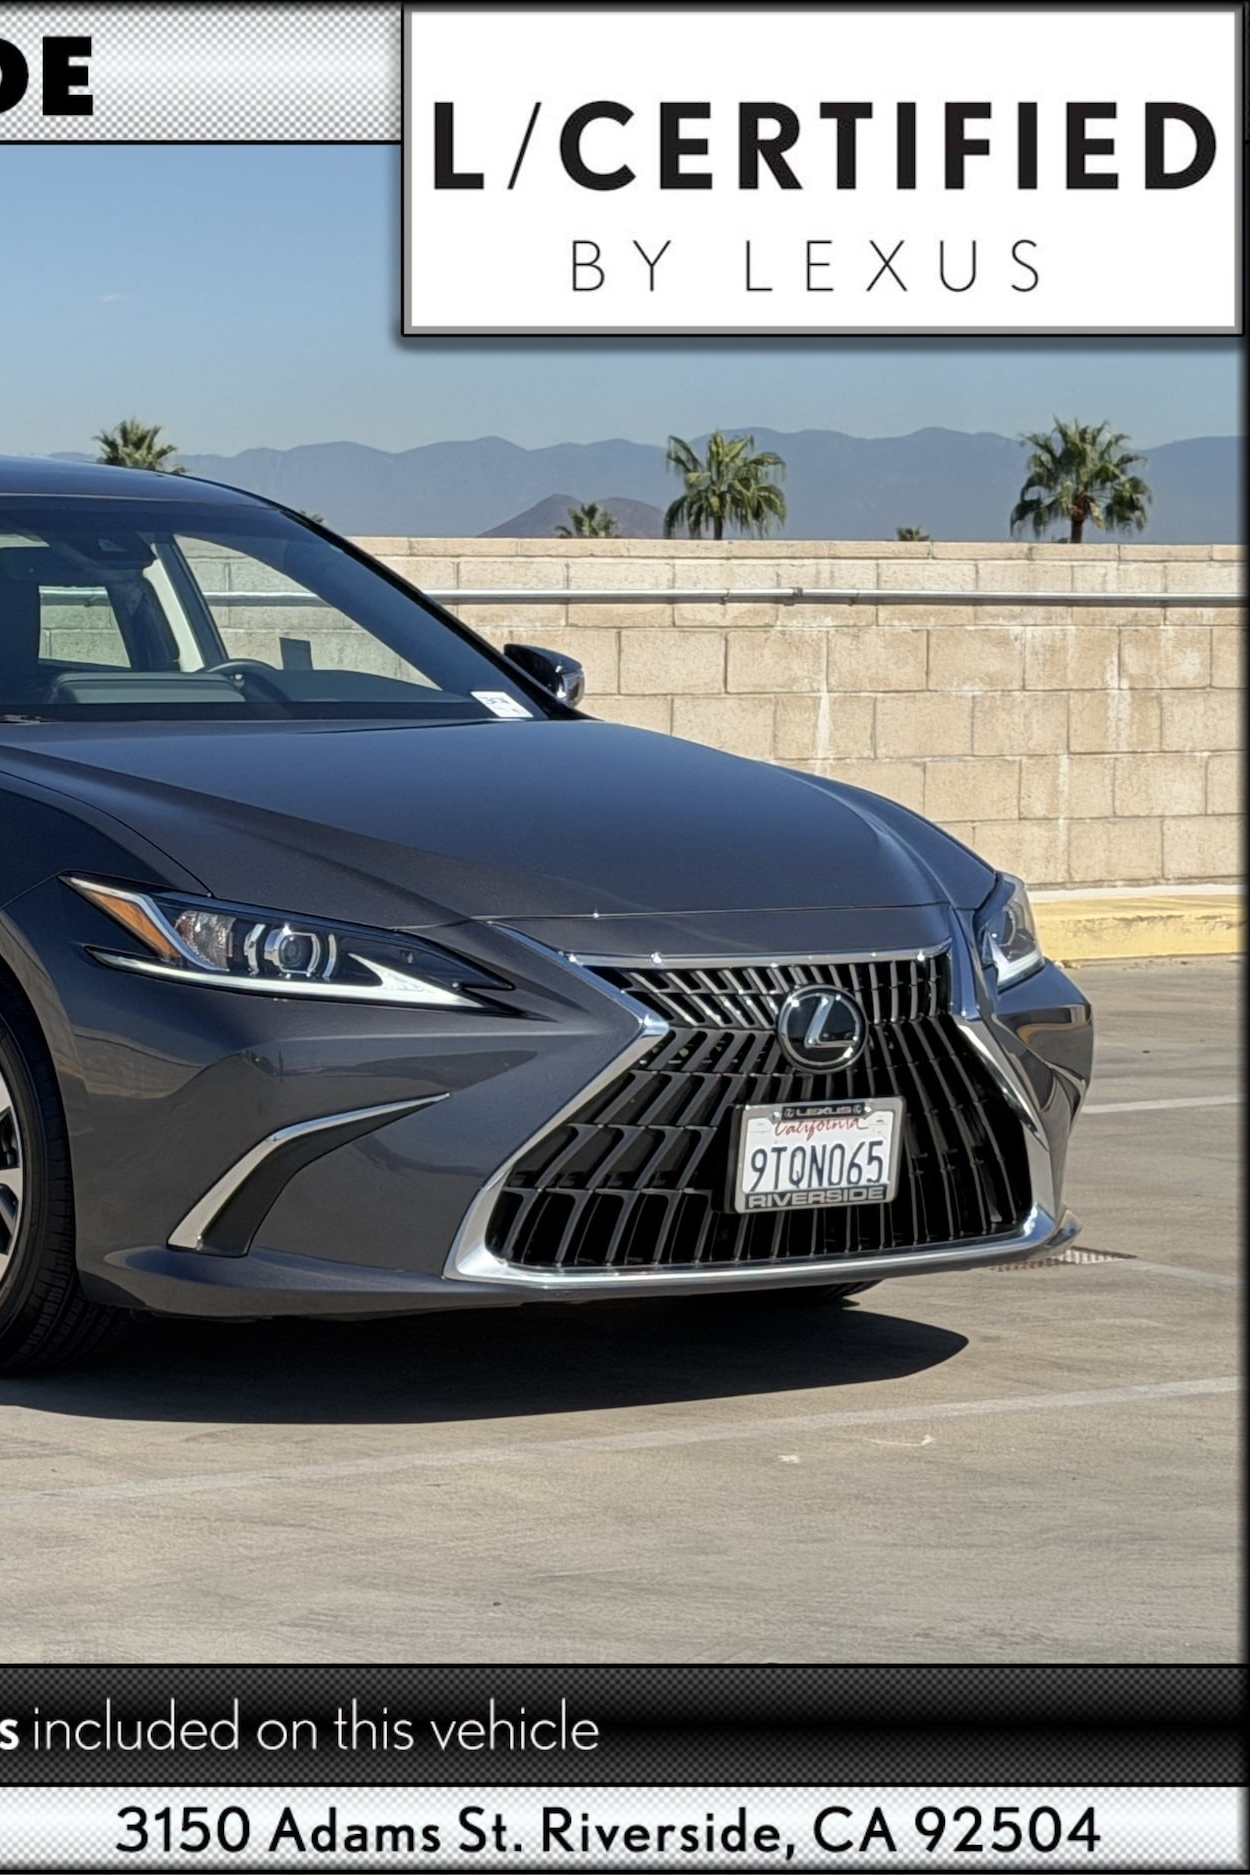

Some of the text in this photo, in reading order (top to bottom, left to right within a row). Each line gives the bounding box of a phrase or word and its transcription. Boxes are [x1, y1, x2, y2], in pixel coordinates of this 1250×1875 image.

[796, 1106, 852, 1117] LEXUS
[774, 1117, 869, 1141] California
[750, 1140, 883, 1192] 9TQN065
[748, 1186, 884, 1209] RIVERSIDE
